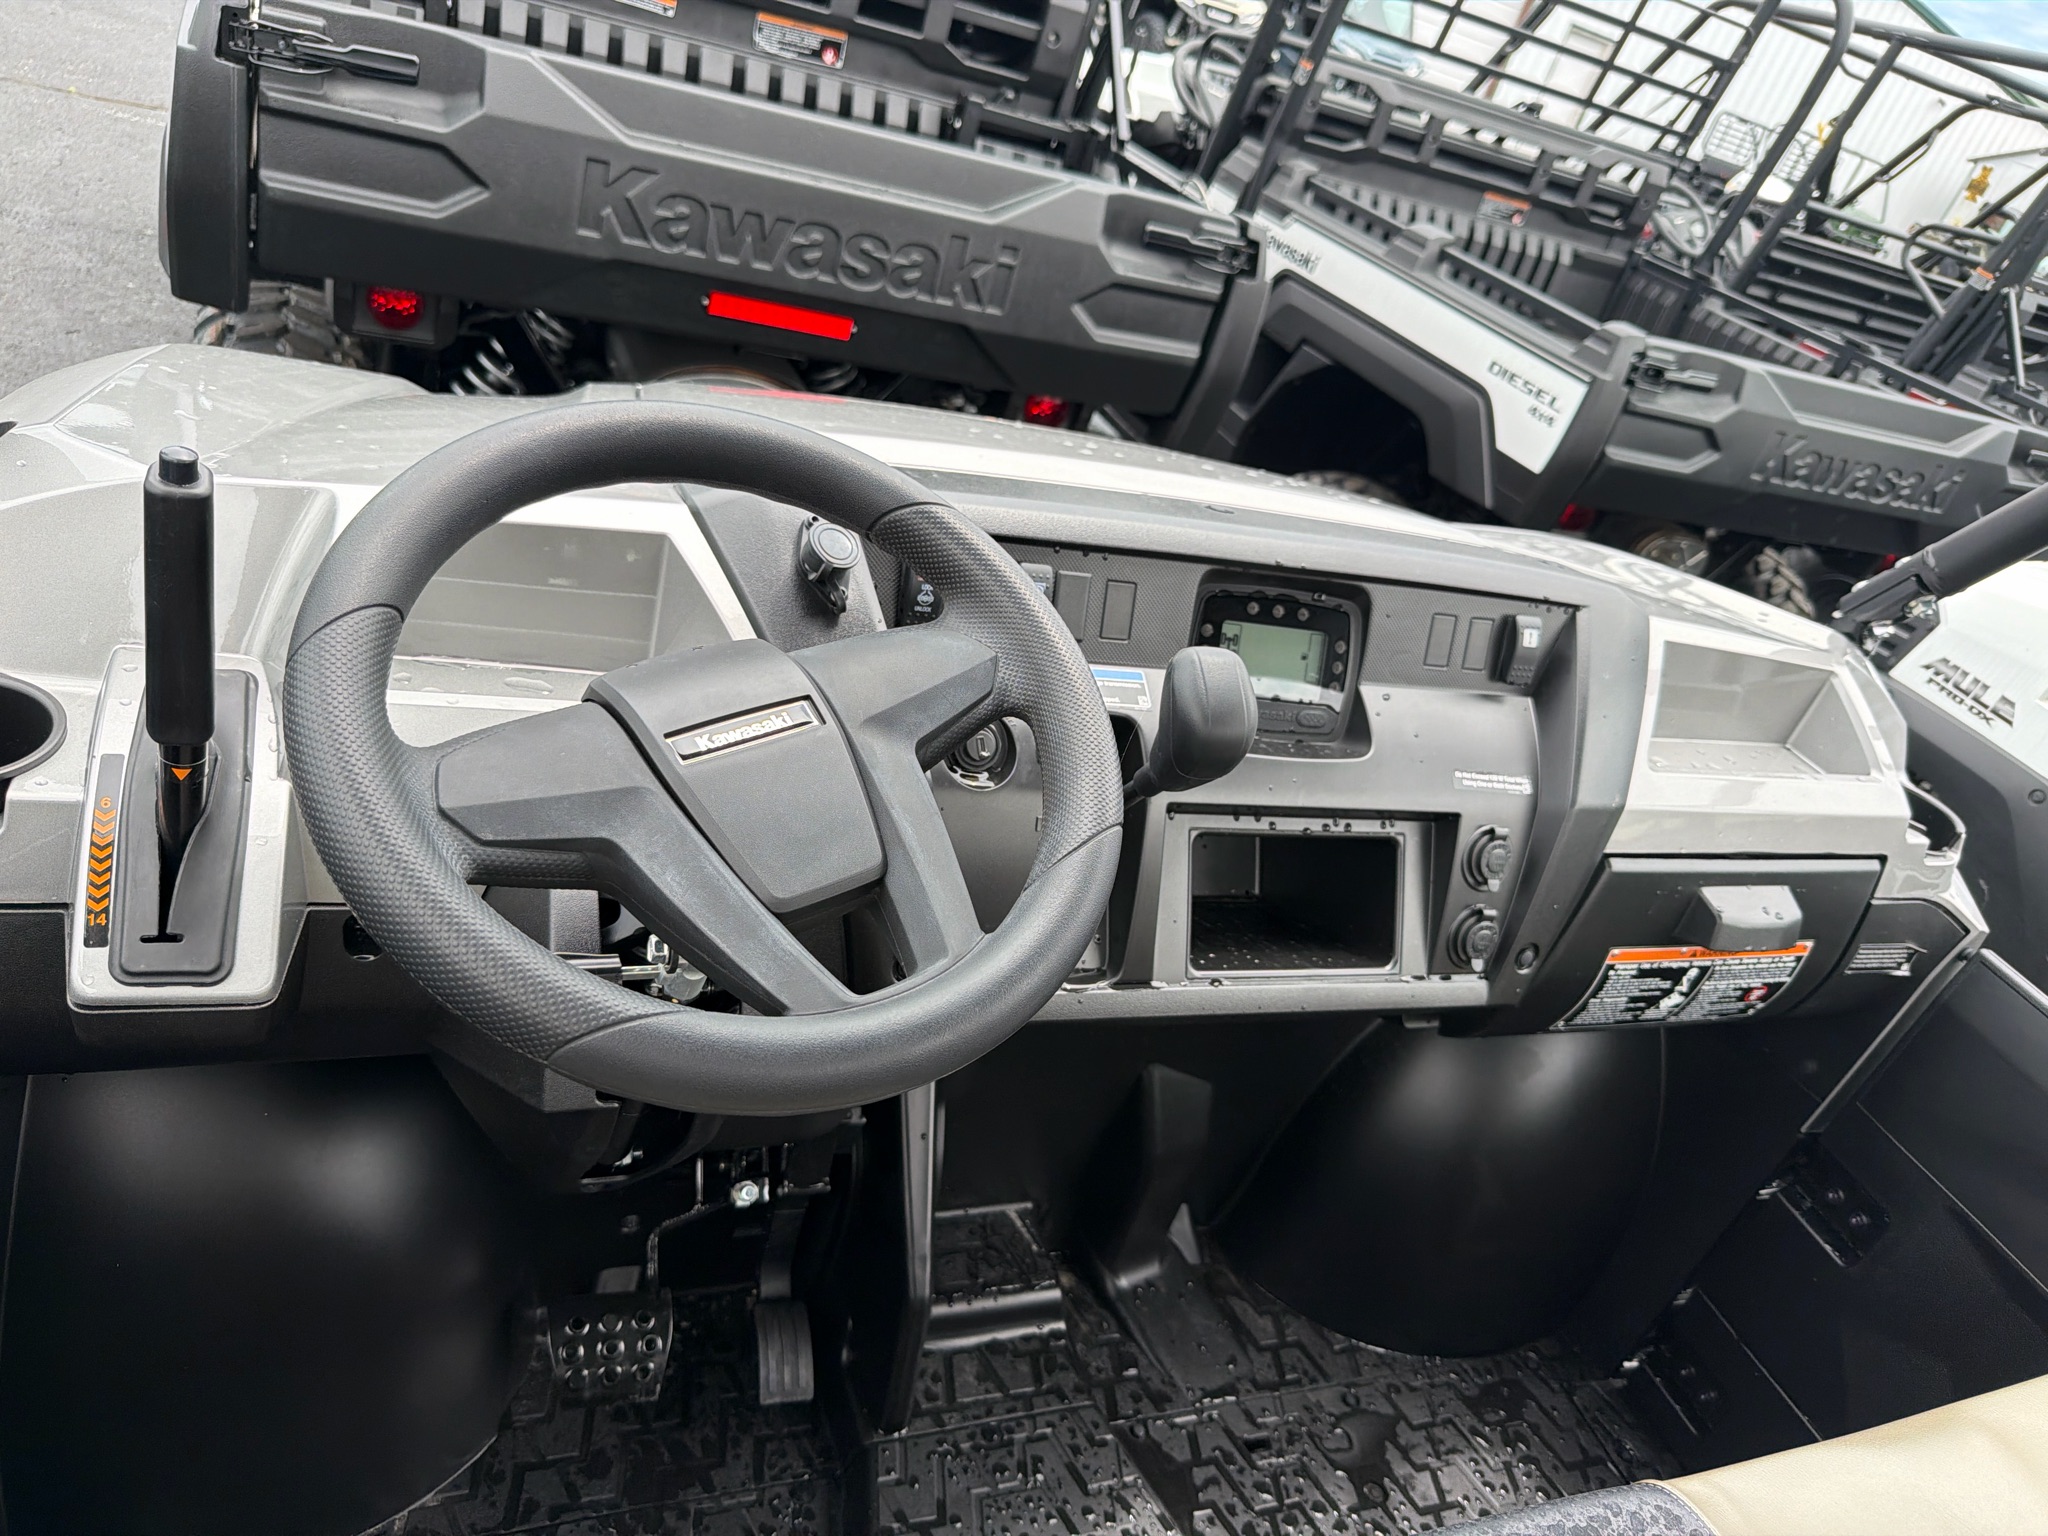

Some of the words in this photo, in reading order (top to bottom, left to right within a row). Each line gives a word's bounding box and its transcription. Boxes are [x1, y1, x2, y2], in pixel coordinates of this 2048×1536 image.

[576, 157, 1021, 316] Kawasaki
[1488, 361, 1560, 414] DIESEL
[1750, 431, 1966, 514] Kawasaki
[1920, 657, 2016, 729] MULE
[1926, 677, 1996, 728] PRO-DX
[694, 711, 795, 752] Kawasaki
[100, 797, 112, 808] 6
[87, 913, 107, 926] 14
